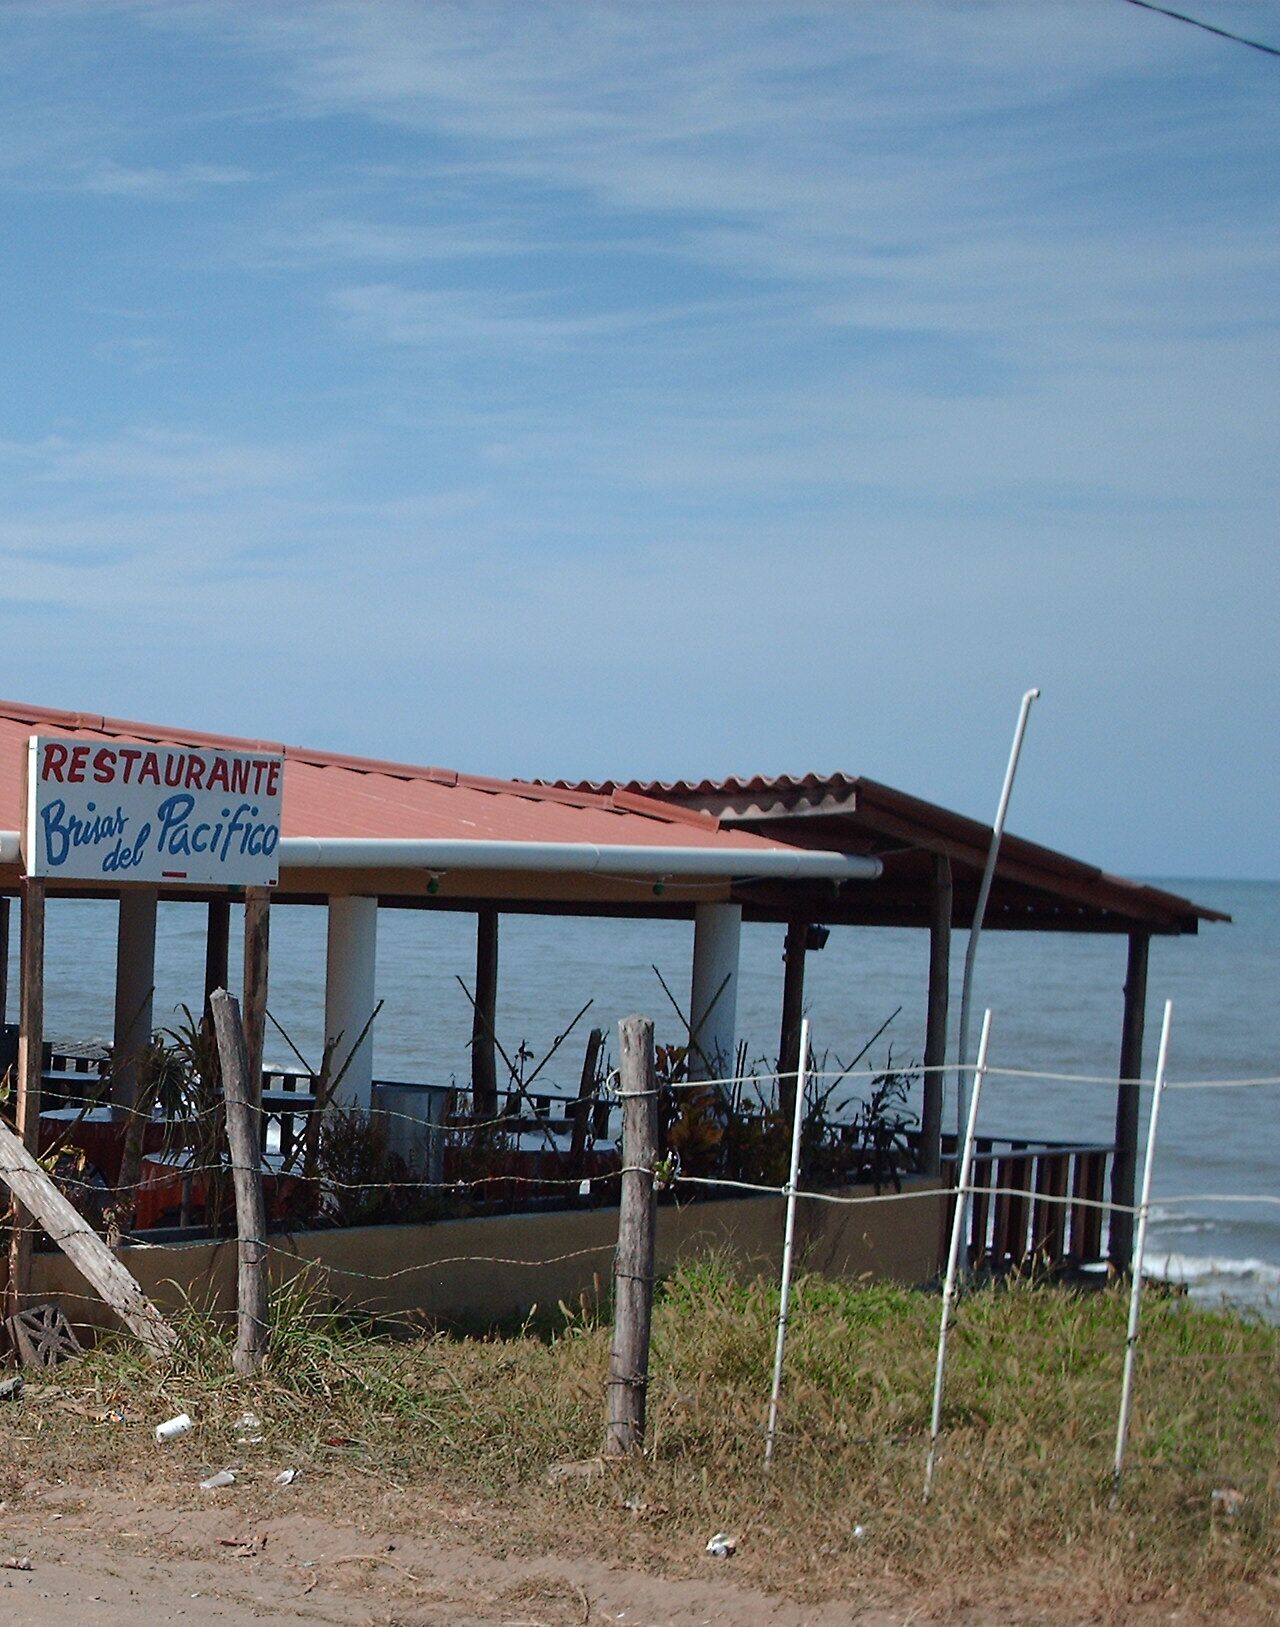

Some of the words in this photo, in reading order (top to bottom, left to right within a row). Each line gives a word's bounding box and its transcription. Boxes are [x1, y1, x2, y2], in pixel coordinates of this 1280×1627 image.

[41, 744, 281, 796] RESTAURANTE
[41, 799, 129, 866] Brisas
[102, 822, 151, 872] del
[157, 793, 279, 862] Pacifico
